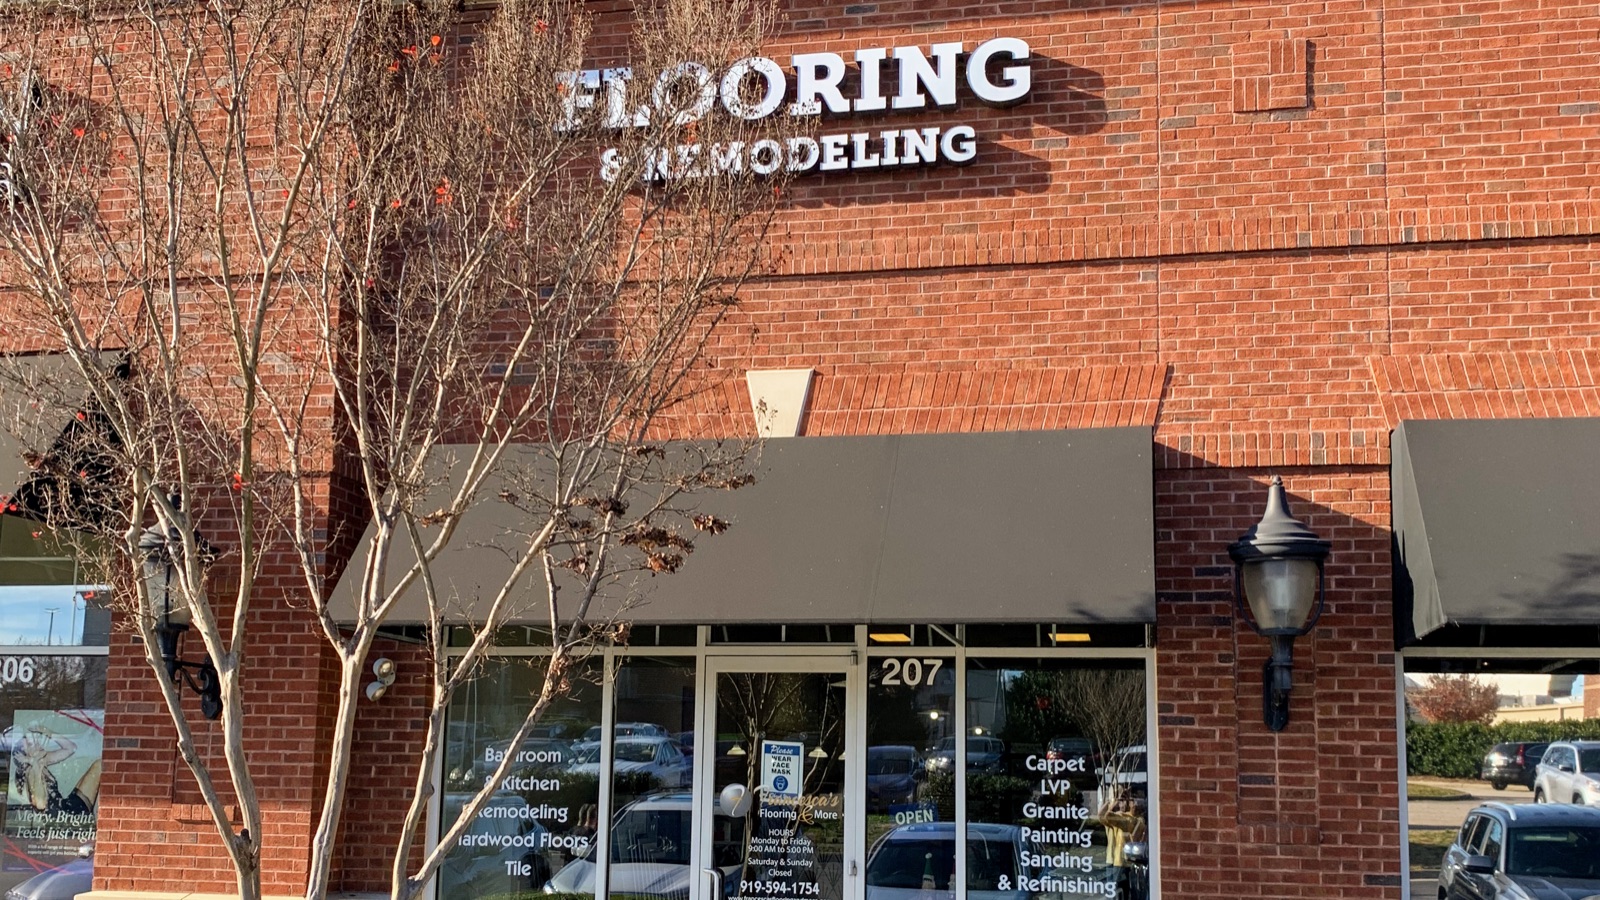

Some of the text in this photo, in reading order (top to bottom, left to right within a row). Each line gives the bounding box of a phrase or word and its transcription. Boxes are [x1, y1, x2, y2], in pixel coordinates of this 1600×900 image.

[0, 656, 33, 683] 06
[881, 658, 943, 686] 207
[485, 747, 561, 762] Baroom
[770, 744, 793, 754] Please
[1026, 755, 1085, 774] Carpet
[501, 776, 560, 791] Kitchen
[1041, 779, 1070, 795] LVP
[56, 810, 95, 826] Bright.
[759, 805, 838, 825] Flooring & More
[895, 809, 933, 825] OPEN
[1023, 802, 1089, 819] Granite
[16, 826, 96, 843] Feels just righ
[540, 833, 589, 848] Floors
[768, 829, 794, 837] HOURS
[1021, 826, 1093, 848] Painting
[751, 836, 780, 846] Monday
[790, 837, 812, 847] Friday
[764, 845, 776, 853] AM
[786, 845, 801, 853] 5:00
[802, 846, 814, 854] PM
[505, 861, 532, 876] Tile
[748, 857, 813, 868] Saturday & Sunday
[1020, 851, 1093, 872] Sanding
[768, 869, 793, 877] Closed
[740, 880, 820, 895] 919-594-1754
[998, 874, 1117, 898] & Refinishing
